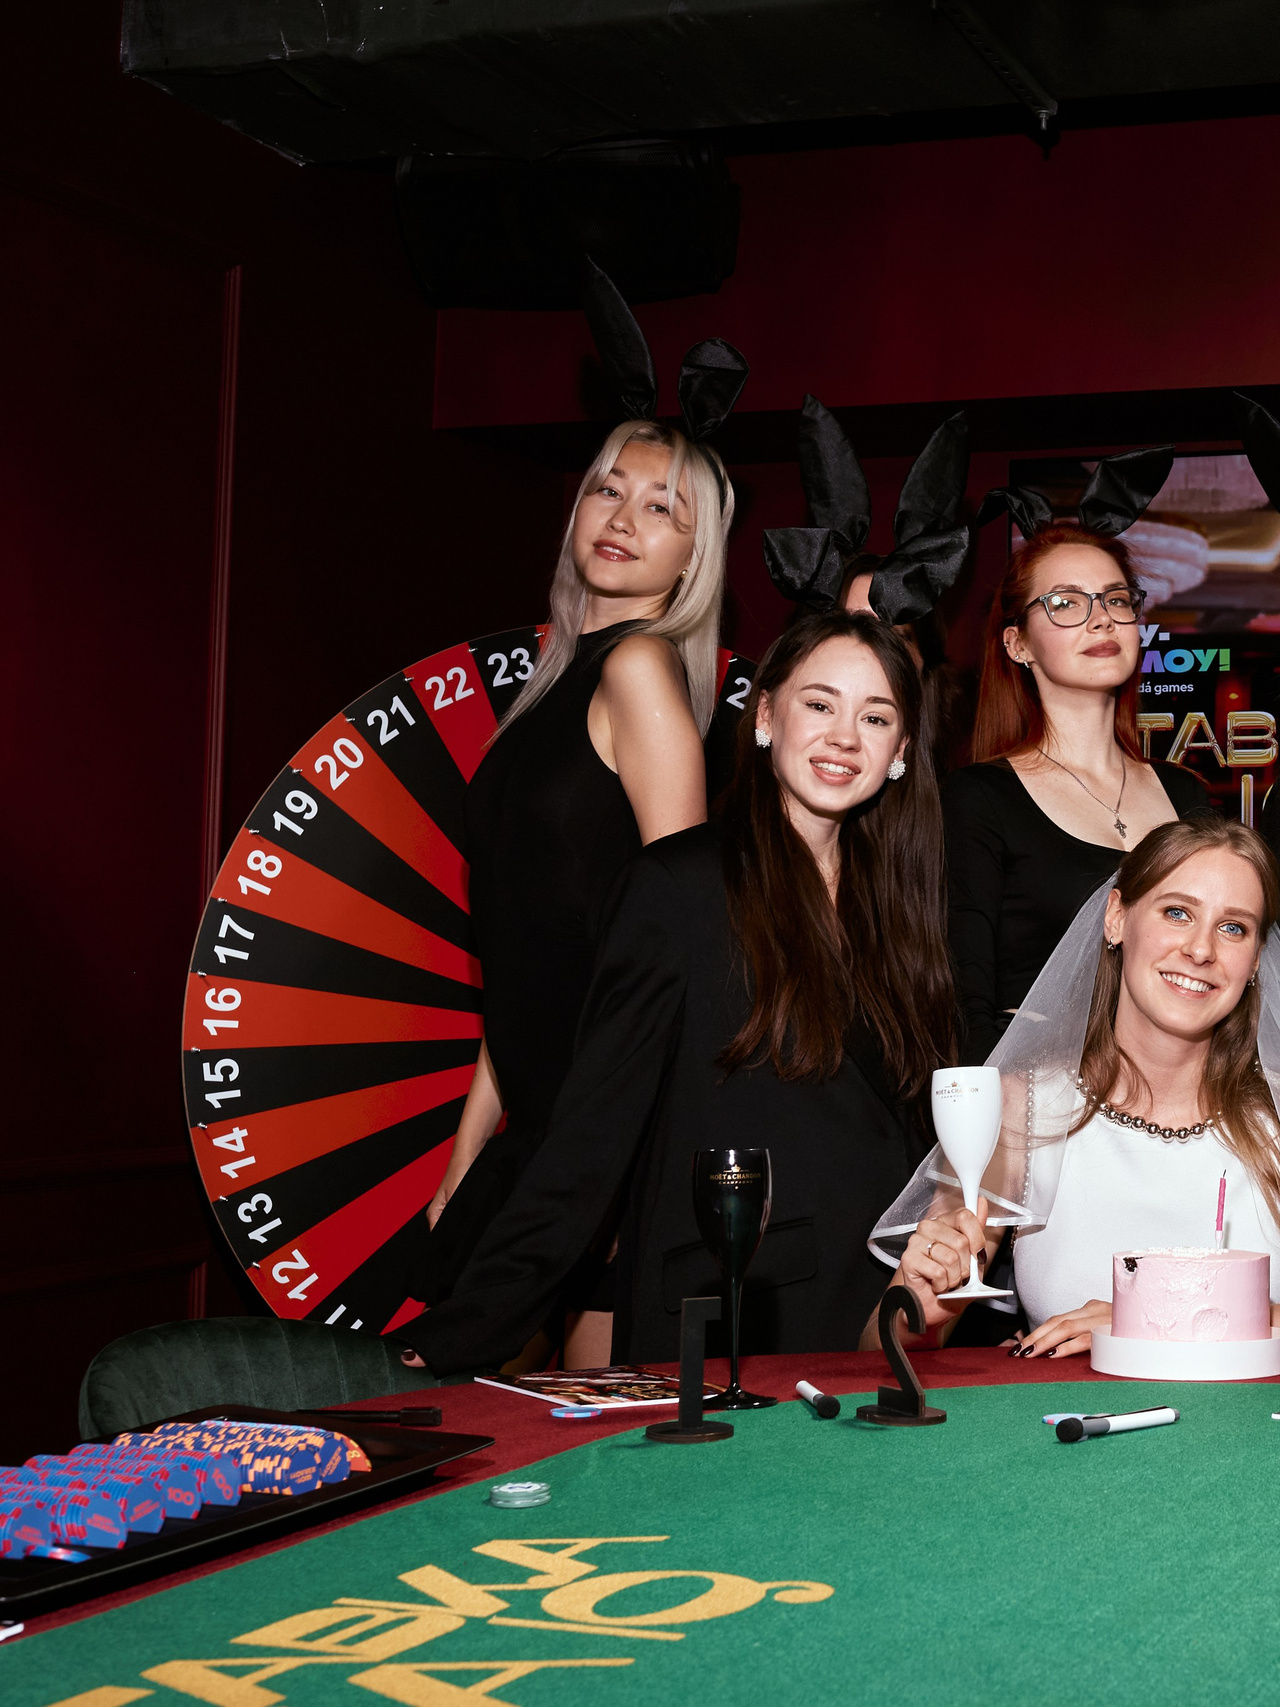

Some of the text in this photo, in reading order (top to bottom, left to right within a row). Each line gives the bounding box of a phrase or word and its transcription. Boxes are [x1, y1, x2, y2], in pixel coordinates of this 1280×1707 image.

[487, 647, 535, 687] 23
[1141, 648, 1230, 673] ЛОУ!
[425, 666, 475, 711] 22
[726, 677, 752, 710] 2
[1154, 683, 1194, 695] games
[366, 695, 416, 746] 21
[314, 737, 364, 791] 20
[272, 790, 318, 836] 19
[237, 849, 282, 896] 18
[213, 914, 255, 964] 17
[202, 987, 242, 1036] 16
[202, 1057, 241, 1109] 15
[212, 1126, 256, 1179] 14
[732, 1172, 761, 1180] CHANDON
[237, 1193, 282, 1244] 13
[271, 1249, 319, 1301] 12
[167, 1486, 195, 1506] 100
[211, 1468, 234, 1500] 100
